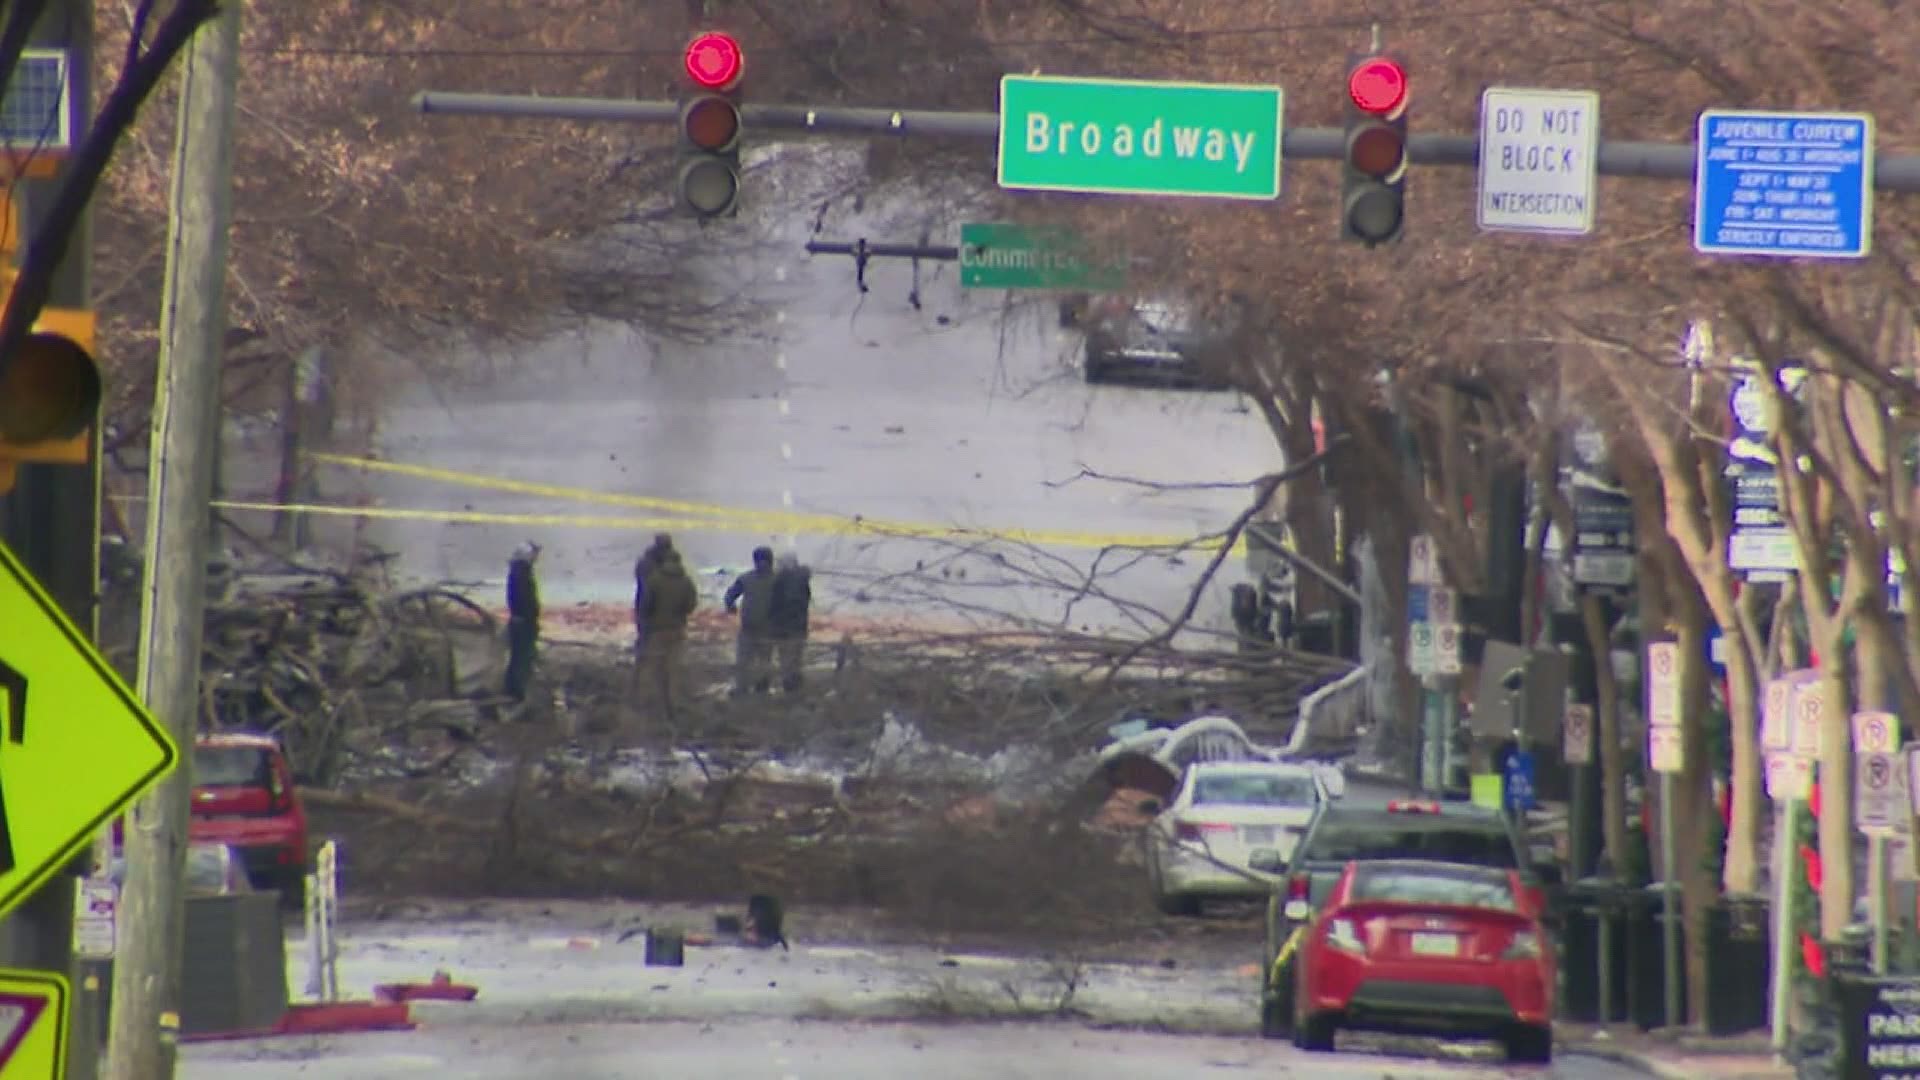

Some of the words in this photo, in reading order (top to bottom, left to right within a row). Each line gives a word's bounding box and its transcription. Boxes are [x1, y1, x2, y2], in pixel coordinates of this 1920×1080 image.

[1496, 108, 1524, 133] DO
[1541, 110, 1581, 134] NOT
[1712, 121, 1788, 138] JUVENILE
[1793, 121, 1857, 140] CURFEW
[1025, 112, 1256, 173] Broadway
[1501, 145, 1574, 172] BLOCK
